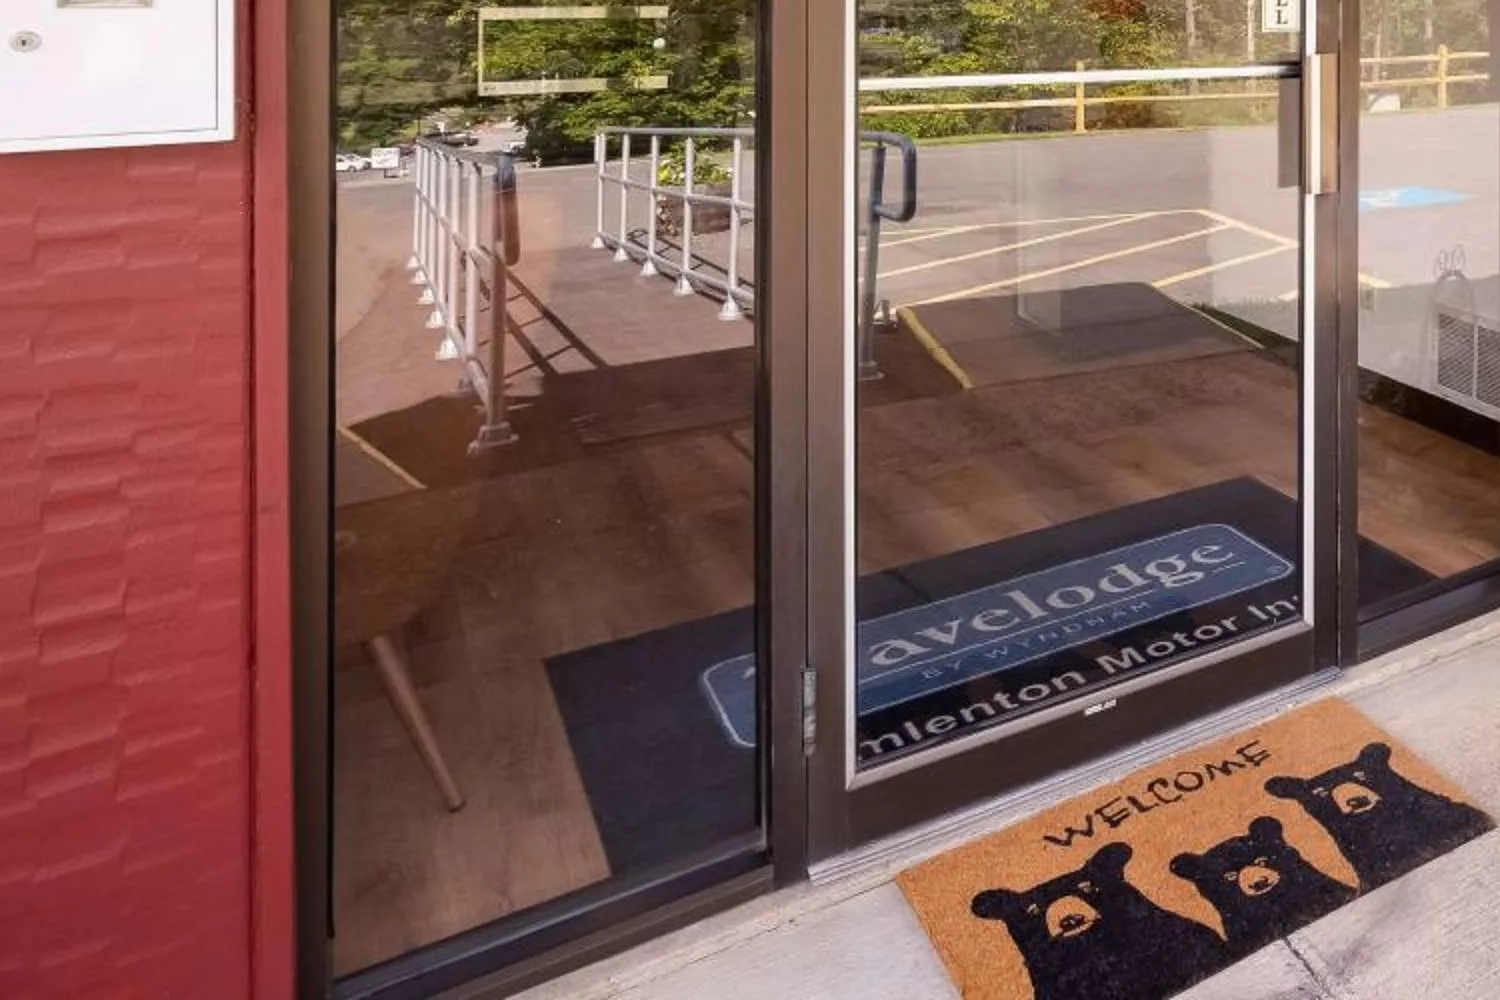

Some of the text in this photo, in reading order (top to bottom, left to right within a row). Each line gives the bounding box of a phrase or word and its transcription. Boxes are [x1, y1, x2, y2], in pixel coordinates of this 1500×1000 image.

[869, 545, 1236, 666] avelodge
[857, 595, 1300, 761] mlenton Motor In
[1043, 740, 1272, 847] WELCOME
